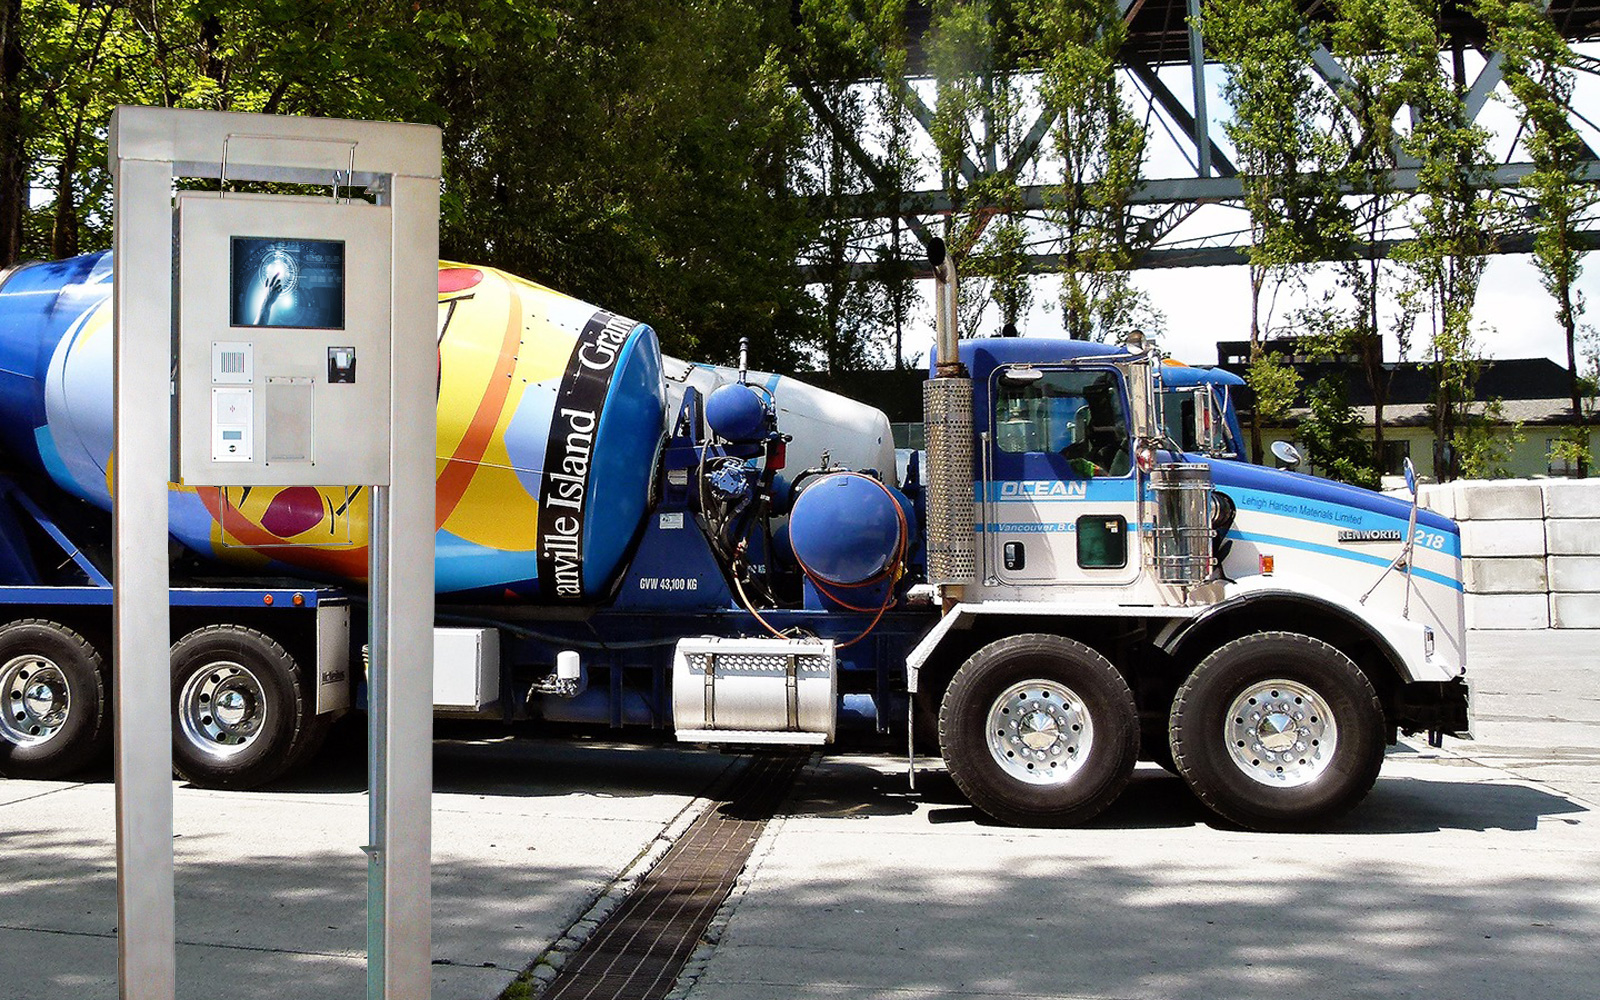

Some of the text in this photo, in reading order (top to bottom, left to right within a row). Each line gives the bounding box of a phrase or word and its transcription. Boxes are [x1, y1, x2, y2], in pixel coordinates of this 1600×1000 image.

[546, 408, 596, 513] Island
[1001, 481, 1087, 496] OCEAN
[1241, 495, 1362, 525] Lehigh Hanson Materials Limited
[1337, 530, 1401, 540] KENWORTH
[1413, 530, 1445, 549] 218
[640, 578, 698, 591] GVW 43,100 KG
